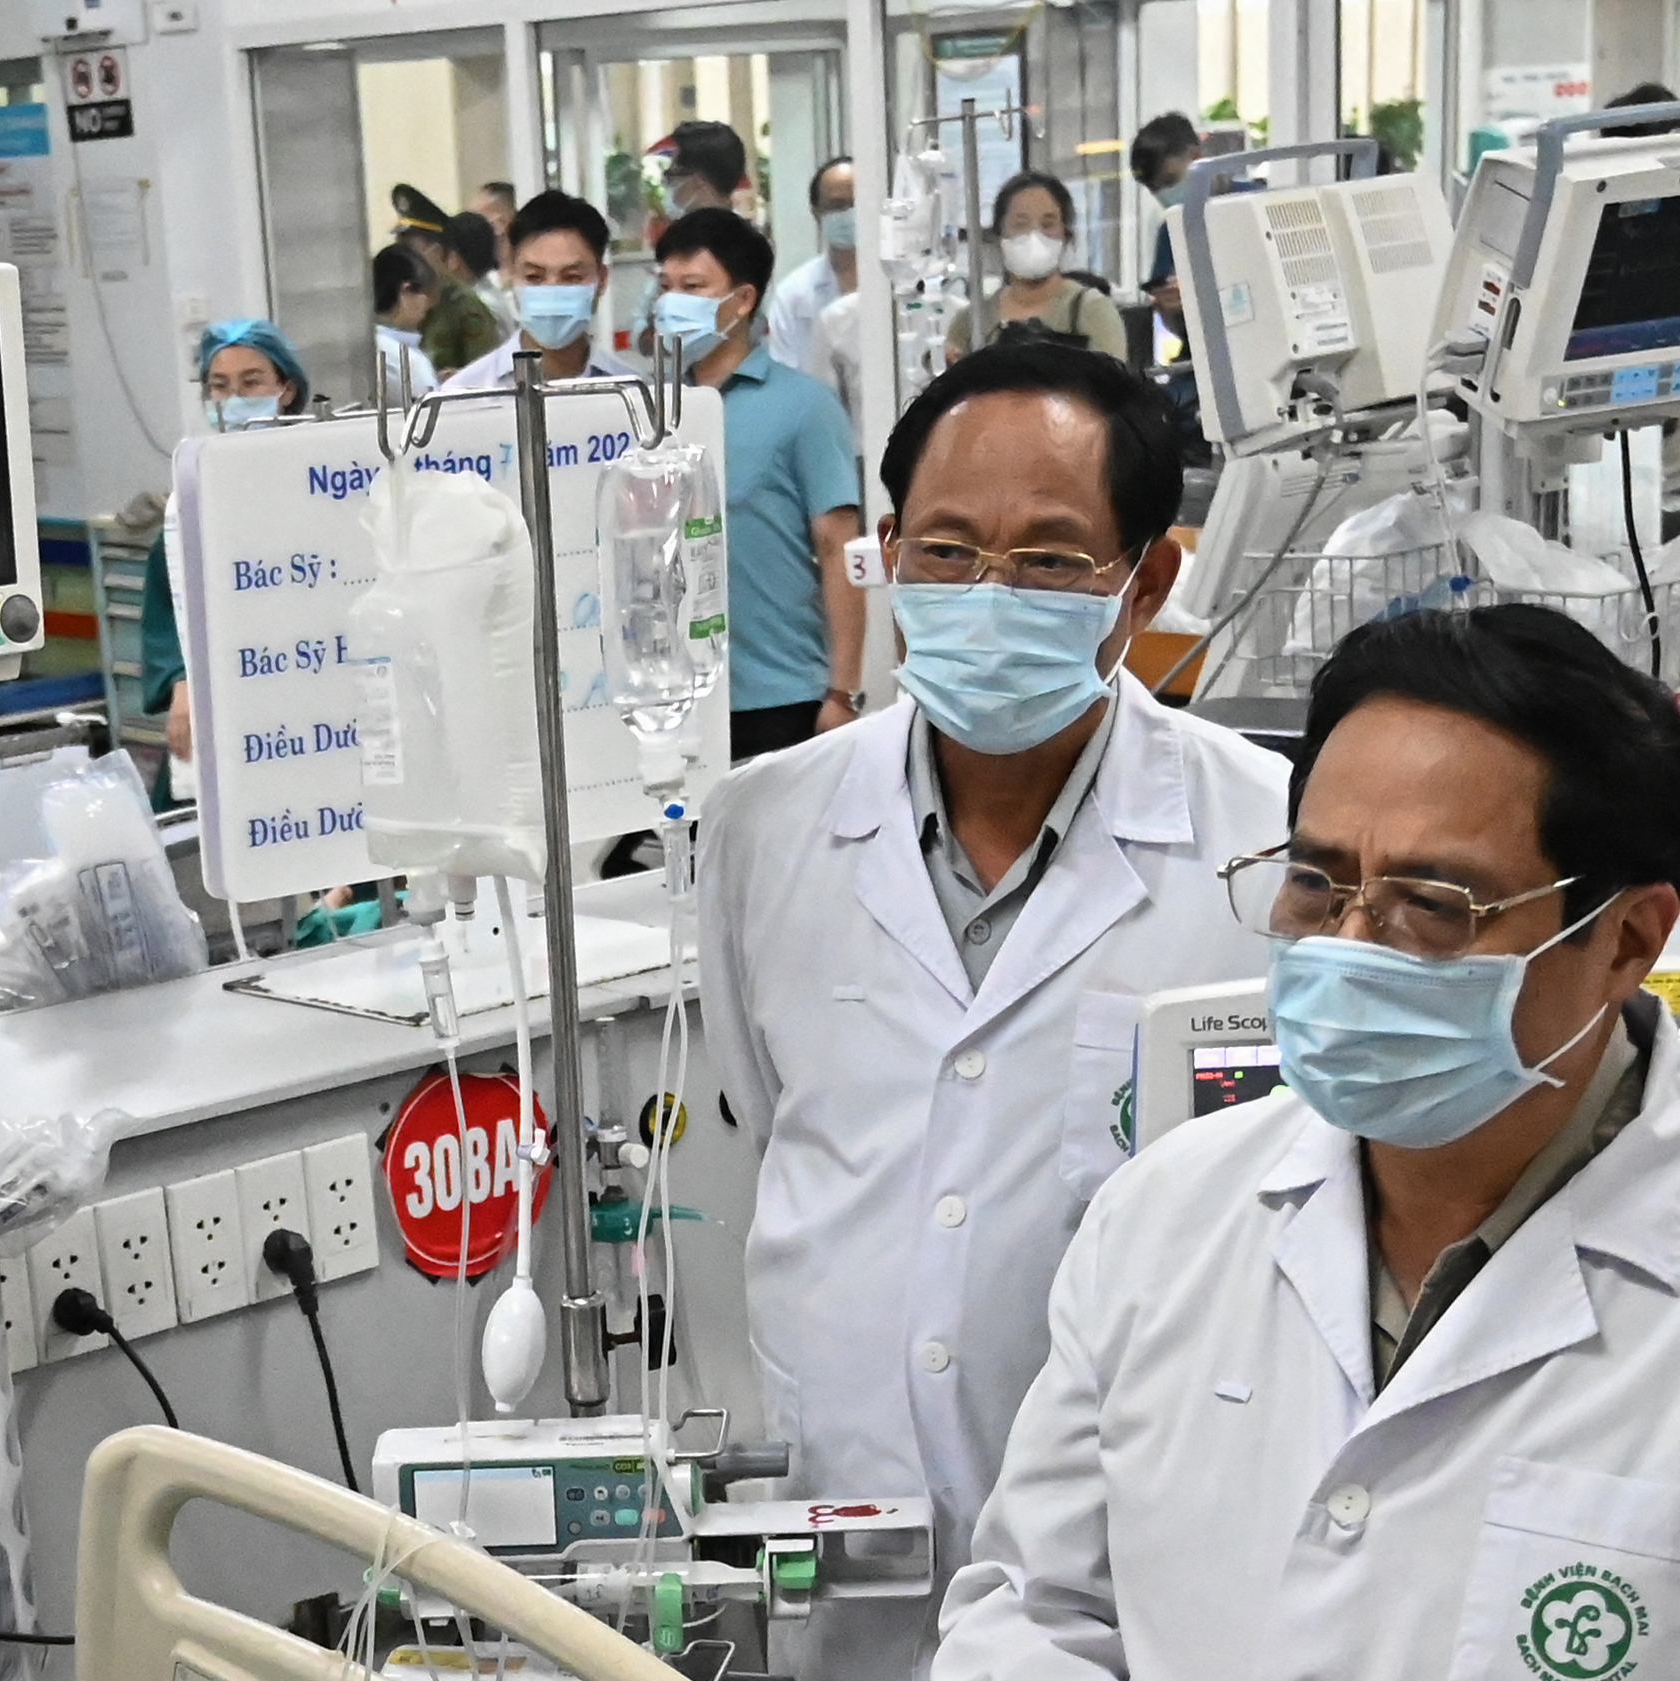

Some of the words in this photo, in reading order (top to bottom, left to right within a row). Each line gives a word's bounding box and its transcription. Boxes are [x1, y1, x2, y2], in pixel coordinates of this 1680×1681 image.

[547, 440, 579, 468] ăm
[309, 461, 381, 500] Ngày
[233, 560, 283, 591] Bác
[290, 553, 322, 589] Sỹ
[853, 554, 866, 580] 3
[239, 647, 288, 678] Bác
[295, 640, 327, 674] Sỹ
[244, 724, 305, 764] Điều
[248, 807, 310, 848] Điều
[1191, 1016, 1223, 1032] Life
[1227, 1015, 1268, 1032] Sco
[1520, 1572, 1556, 1609] BỆNH
[1558, 1562, 1597, 1580] VIỆN
[1634, 1605, 1650, 1637] MAI
[1516, 1634, 1542, 1673] BACH
